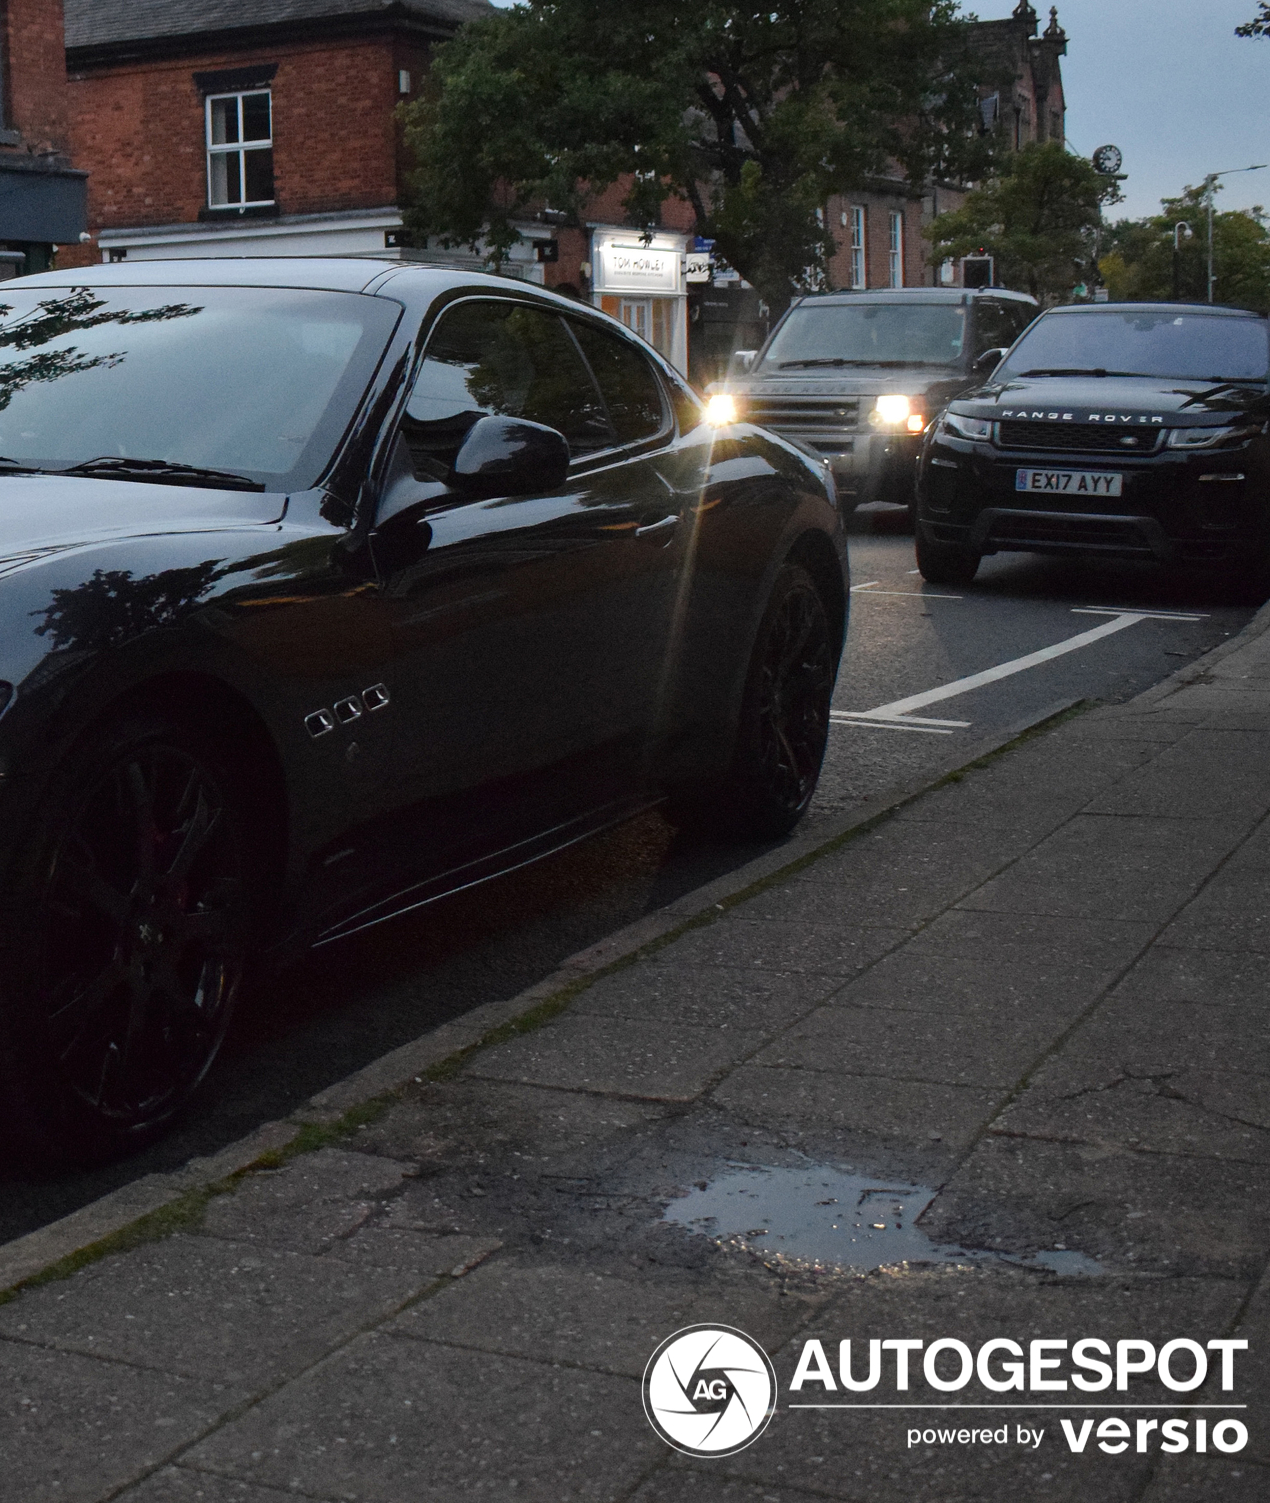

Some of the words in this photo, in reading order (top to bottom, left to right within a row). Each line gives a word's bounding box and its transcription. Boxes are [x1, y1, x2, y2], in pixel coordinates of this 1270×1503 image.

[613, 256, 631, 269] TOM
[633, 258, 665, 271] HOWLEY
[1002, 410, 1074, 421] RANGE
[1088, 414, 1164, 424] ROVER
[1031, 472, 1072, 490] EX17
[1077, 475, 1115, 493] AYY
